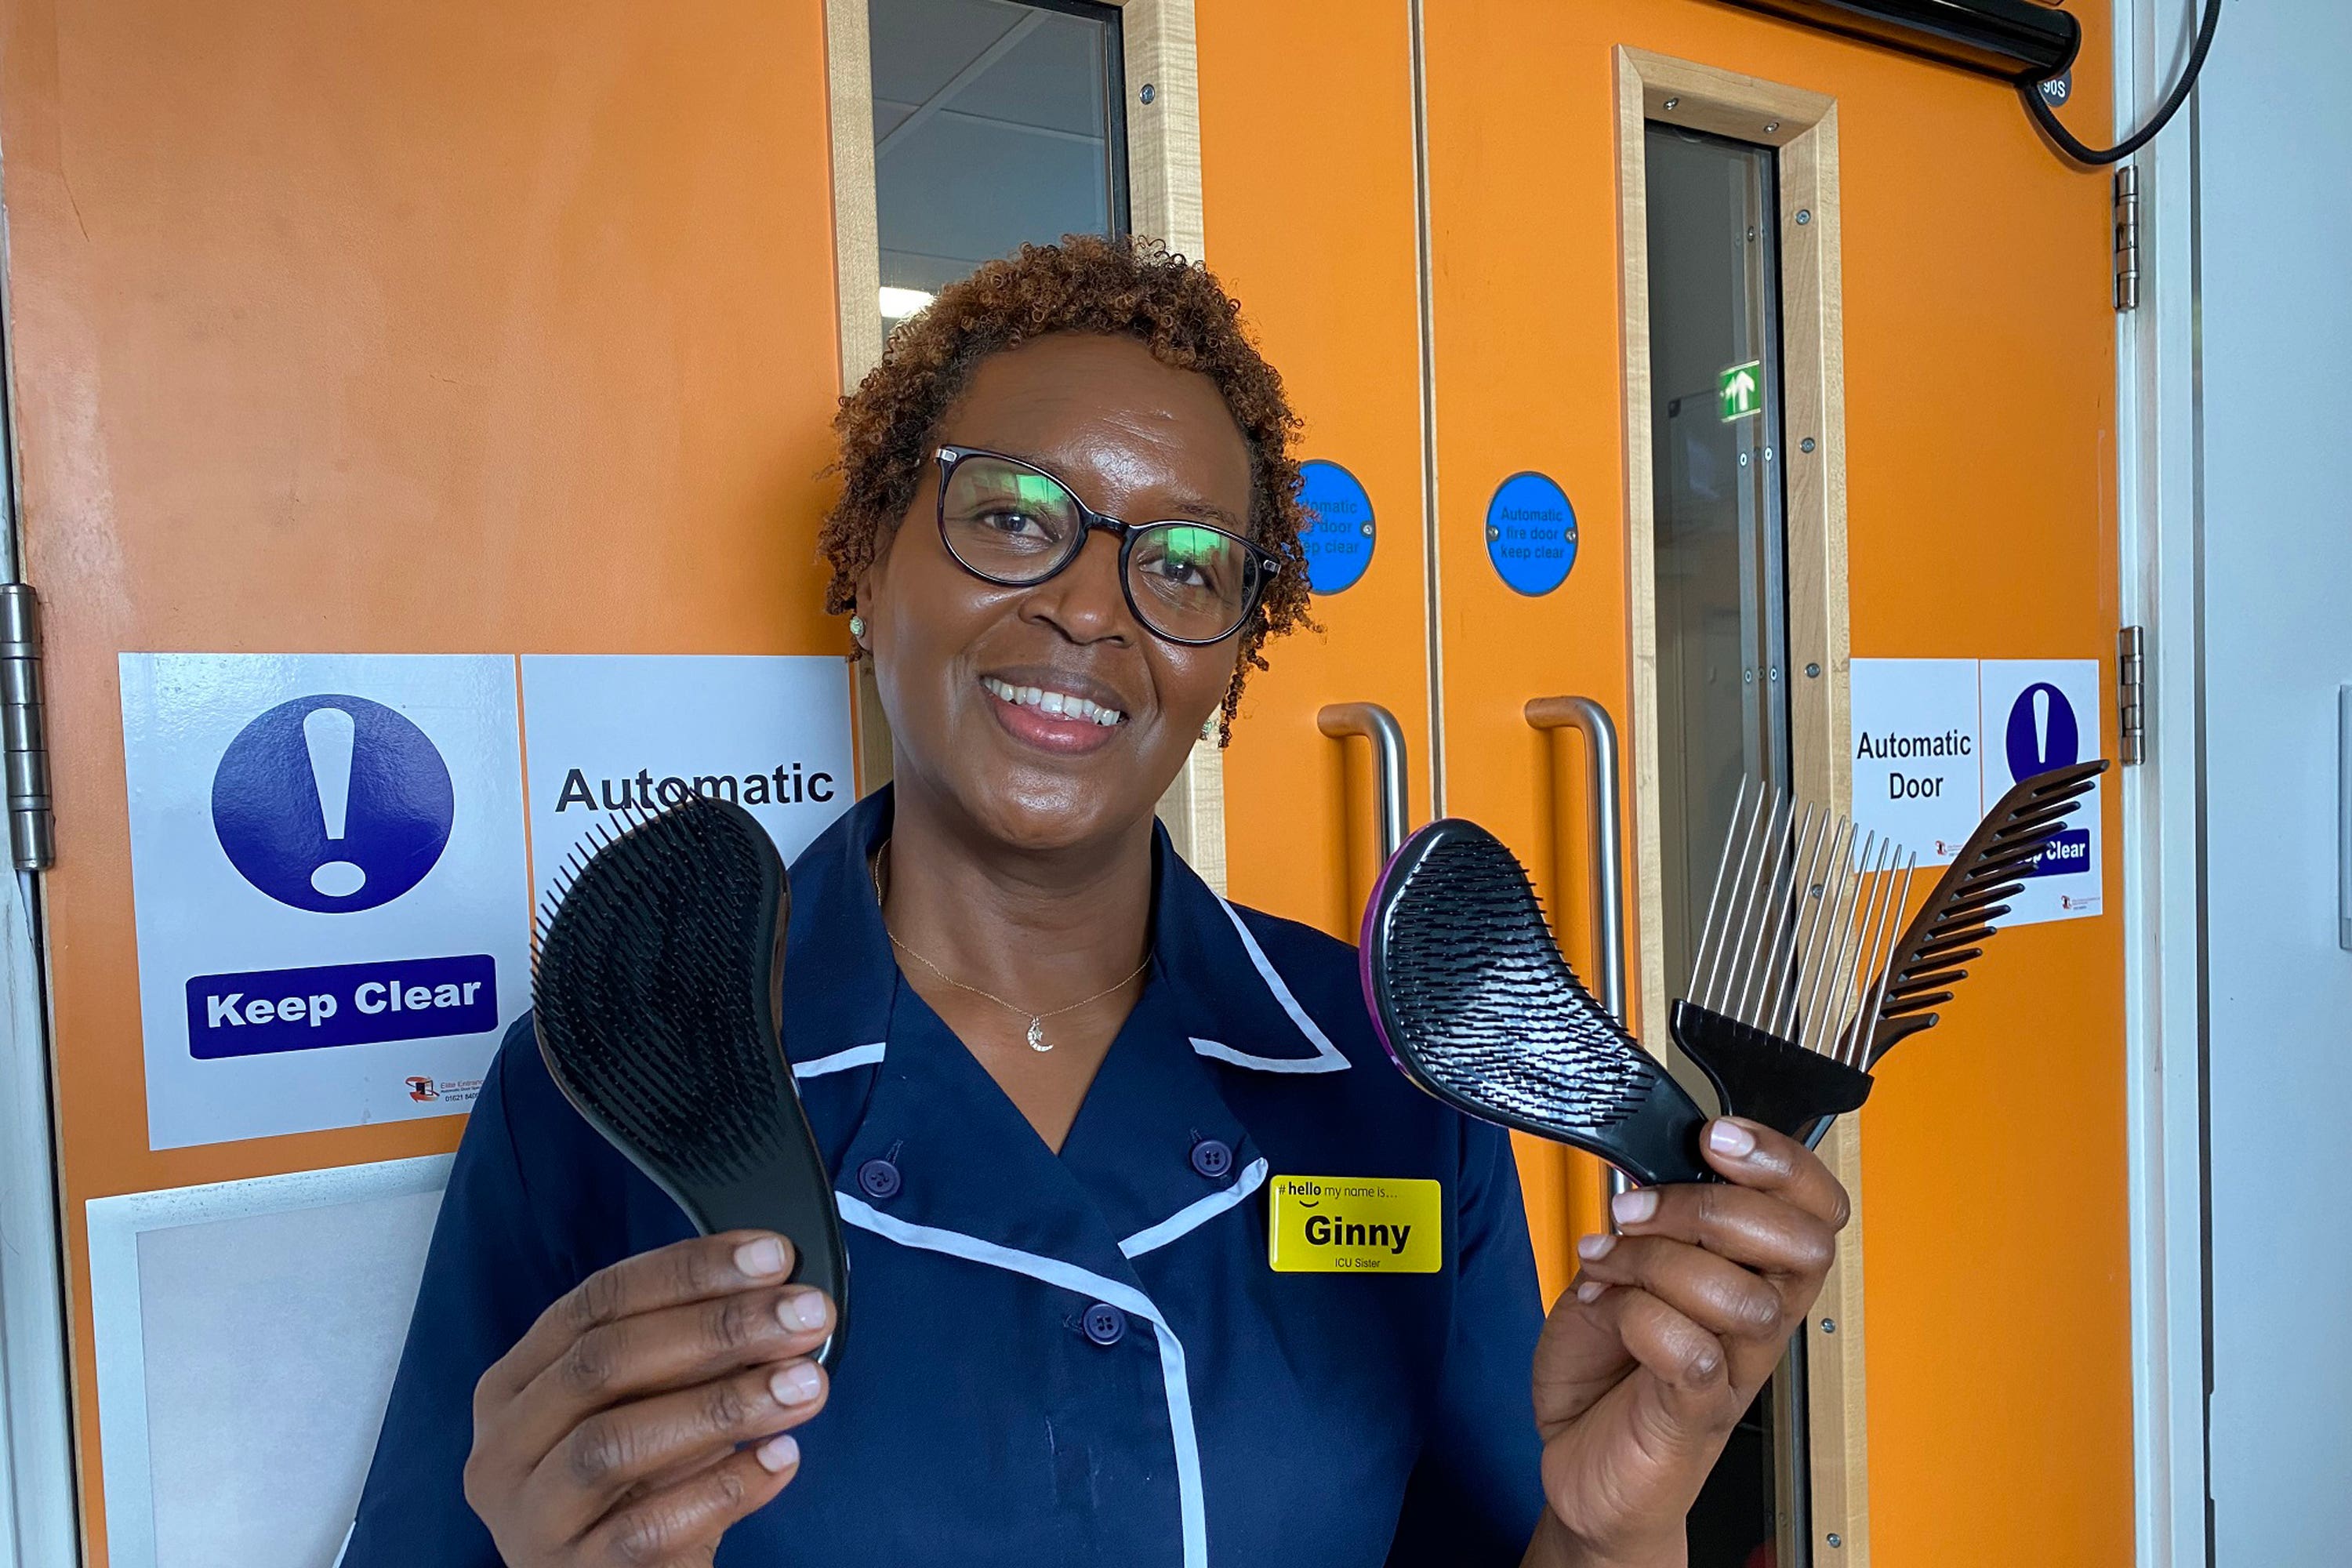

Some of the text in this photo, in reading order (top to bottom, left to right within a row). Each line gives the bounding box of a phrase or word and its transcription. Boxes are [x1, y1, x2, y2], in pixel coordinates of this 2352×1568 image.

[2043, 79, 2066, 98] 90S
[1501, 506, 1563, 521] Automatic
[1319, 518, 1353, 533] door
[1507, 526, 1559, 540] fire door
[1303, 539, 1359, 556] ep clear
[1501, 545, 1565, 560] keep clear
[1857, 728, 1972, 760] Automatic
[554, 762, 835, 813] Automatic
[1889, 772, 1944, 800] Door
[206, 980, 482, 1029] Keep Clear
[457, 1079, 484, 1088] Entranc
[1324, 1187, 1341, 1200] my
[1344, 1187, 1374, 1198] name
[1305, 1215, 1411, 1255] Ginny
[1334, 1258, 1381, 1268] ICU Sister
